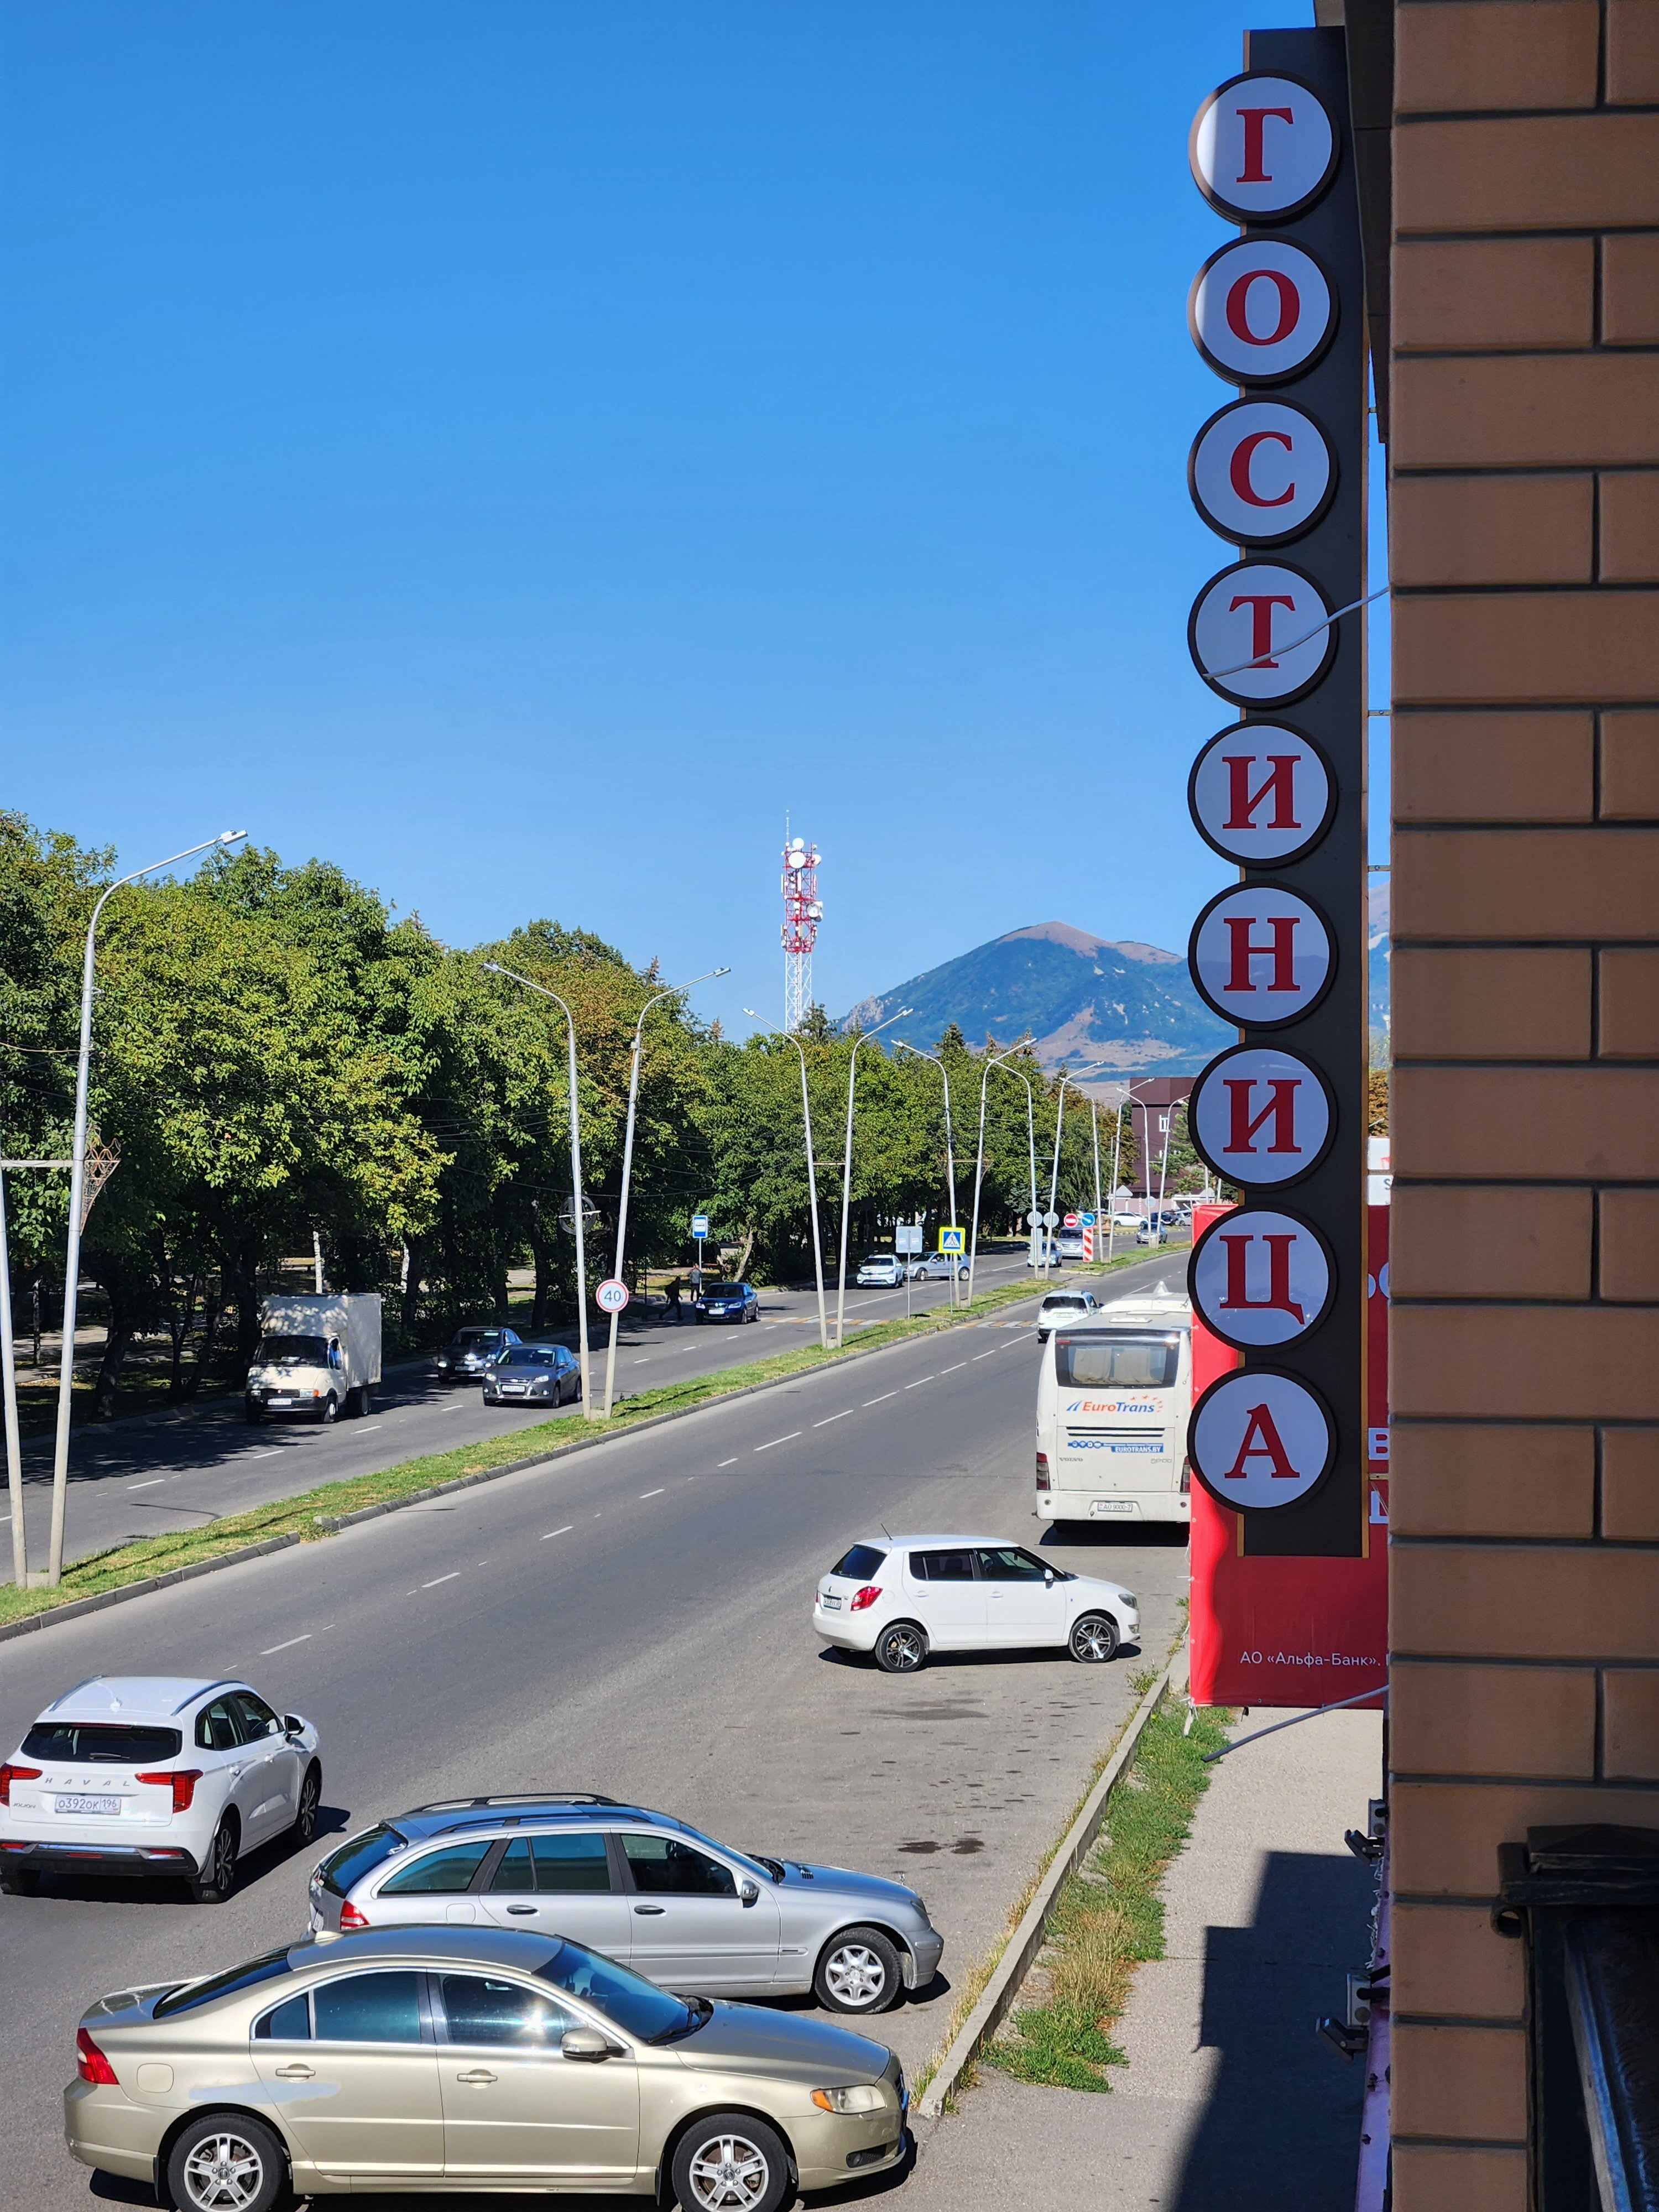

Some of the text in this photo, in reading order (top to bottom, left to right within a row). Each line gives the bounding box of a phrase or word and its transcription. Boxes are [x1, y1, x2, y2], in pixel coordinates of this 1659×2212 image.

[1222, 108, 1303, 1479] ГОСТИНИЦА
[604, 1290, 622, 1302] 40
[1082, 1401, 1155, 1412] EuroTrans
[1240, 1651, 1381, 1668] АО «Альфа-Банк».
[45, 1777, 130, 1787] HAVAL
